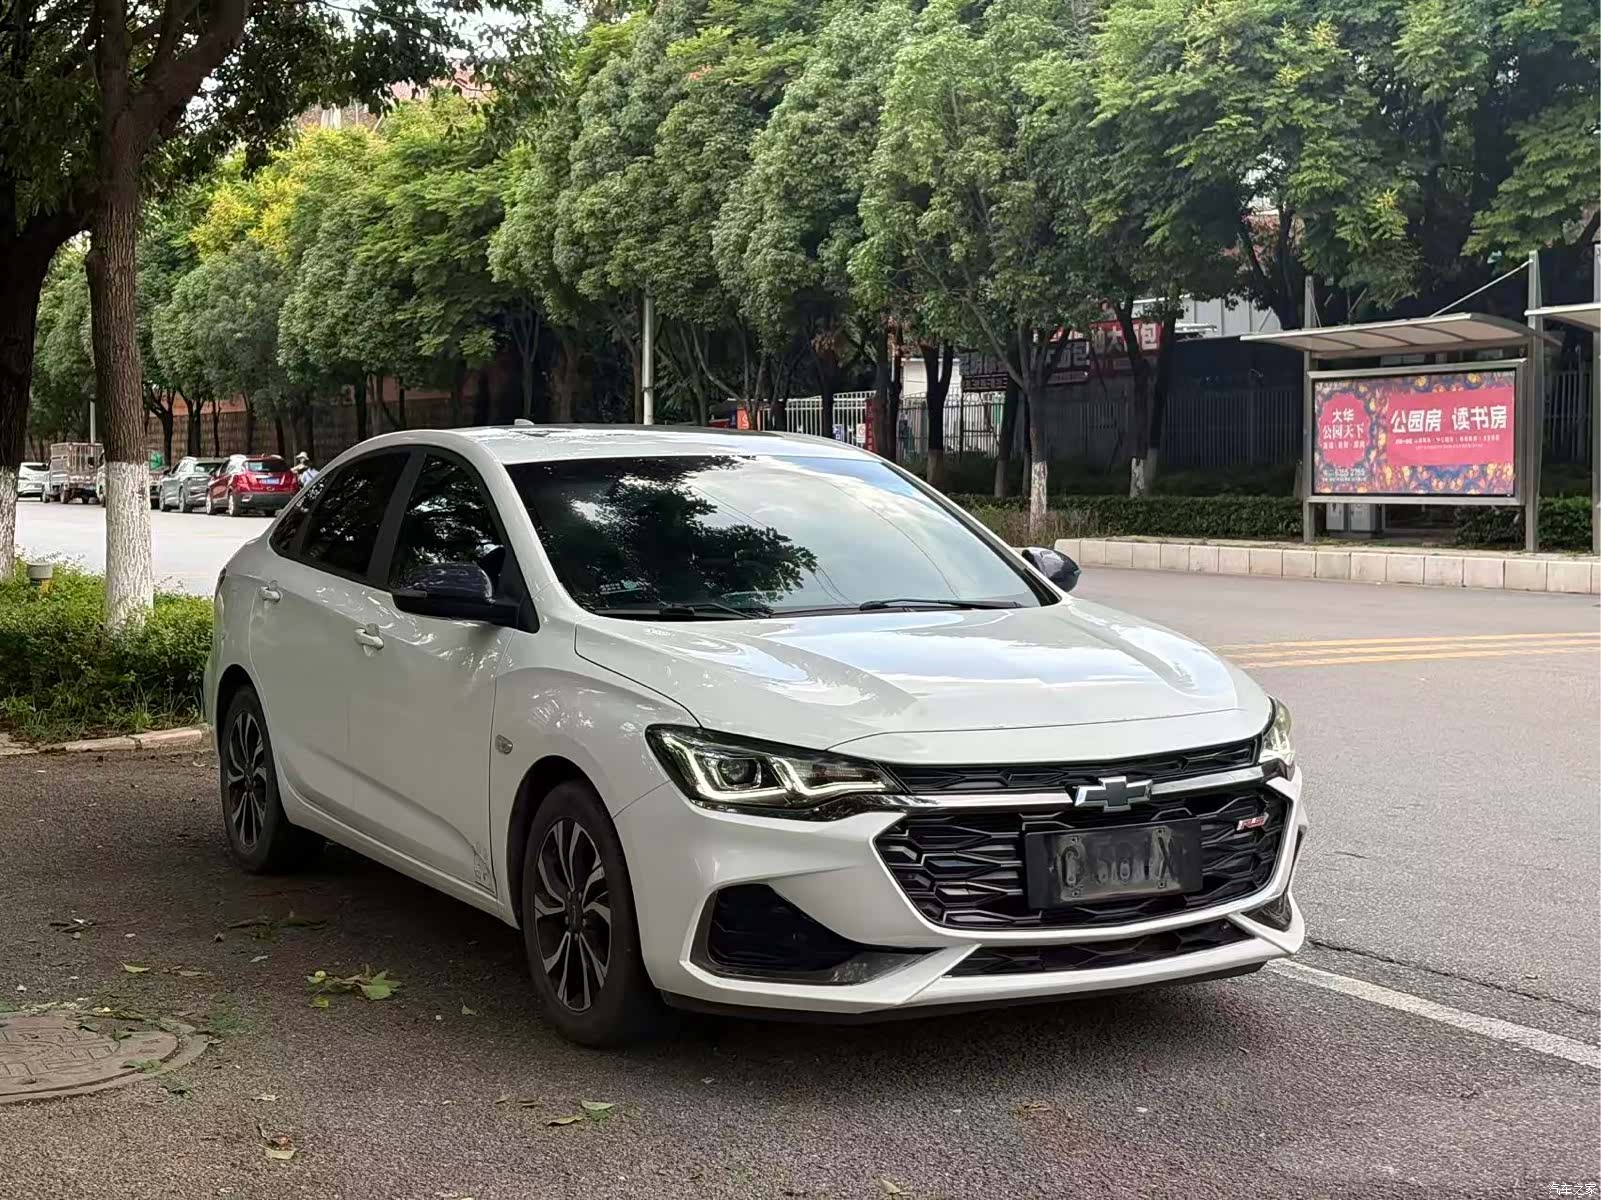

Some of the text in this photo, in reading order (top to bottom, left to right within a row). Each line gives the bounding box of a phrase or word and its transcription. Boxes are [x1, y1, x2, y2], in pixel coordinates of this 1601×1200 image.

[1332, 407, 1355, 424] 大华
[1390, 405, 1508, 433] 公园房 读书房
[1322, 423, 1364, 440] 公园天下
